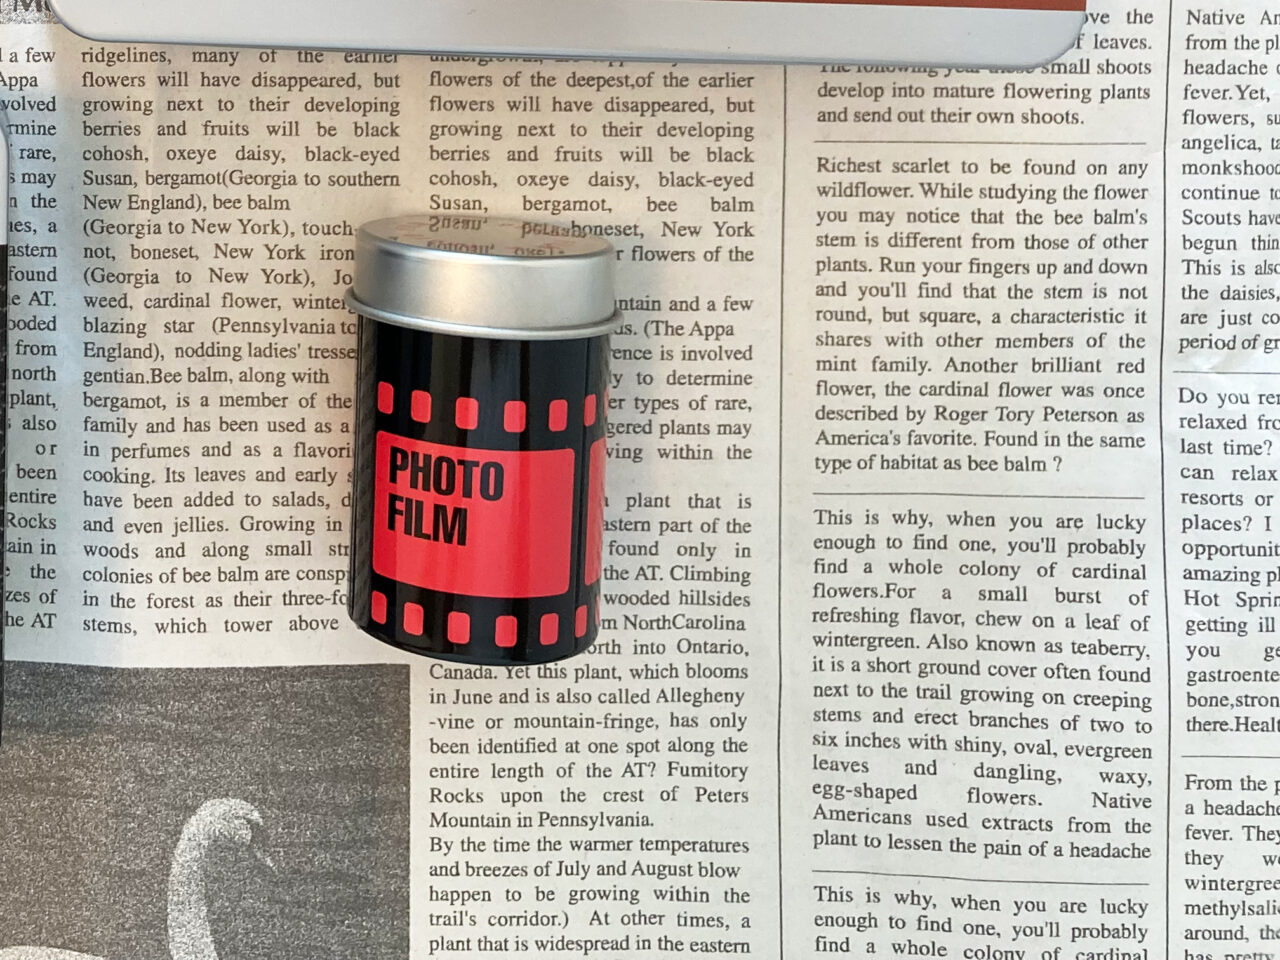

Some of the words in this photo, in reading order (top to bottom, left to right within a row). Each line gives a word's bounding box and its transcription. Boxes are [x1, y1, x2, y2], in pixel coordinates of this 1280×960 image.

[82, 72, 145, 87] flowers
[157, 71, 188, 86] will
[201, 72, 240, 87] have
[252, 72, 361, 92] disappeared,
[374, 72, 400, 88] but
[818, 107, 848, 122] and
[854, 107, 891, 122] send
[898, 110, 924, 122] out
[931, 108, 971, 123] their
[977, 112, 1014, 123] own
[1022, 108, 1084, 124] shoots.
[83, 195, 122, 210] New
[128, 194, 206, 214] England),
[213, 194, 241, 209] bee
[247, 194, 290, 210] balm
[187, 366, 232, 384] balm,
[239, 367, 286, 387] along
[292, 368, 329, 383] with
[1181, 438, 1212, 454] last
[1224, 440, 1272, 455] time?
[389, 445, 504, 501] PHOTO
[1181, 493, 1243, 506] resorts
[1255, 495, 1273, 506] or
[387, 492, 468, 546] FILM
[813, 754, 869, 773] leaves
[905, 760, 937, 775] and
[974, 762, 1061, 785] dangling,
[1099, 772, 1151, 788] waxy,
[430, 788, 483, 803] Rocks
[501, 792, 542, 807] upon
[561, 787, 586, 802] the
[603, 790, 644, 802] crest
[660, 786, 679, 801] of
[696, 787, 748, 802] Peters
[968, 787, 1042, 806] flowers.
[1092, 792, 1151, 808] Native
[430, 812, 511, 828] Mountain
[518, 812, 532, 827] in
[538, 812, 653, 831] Pennsylvania.
